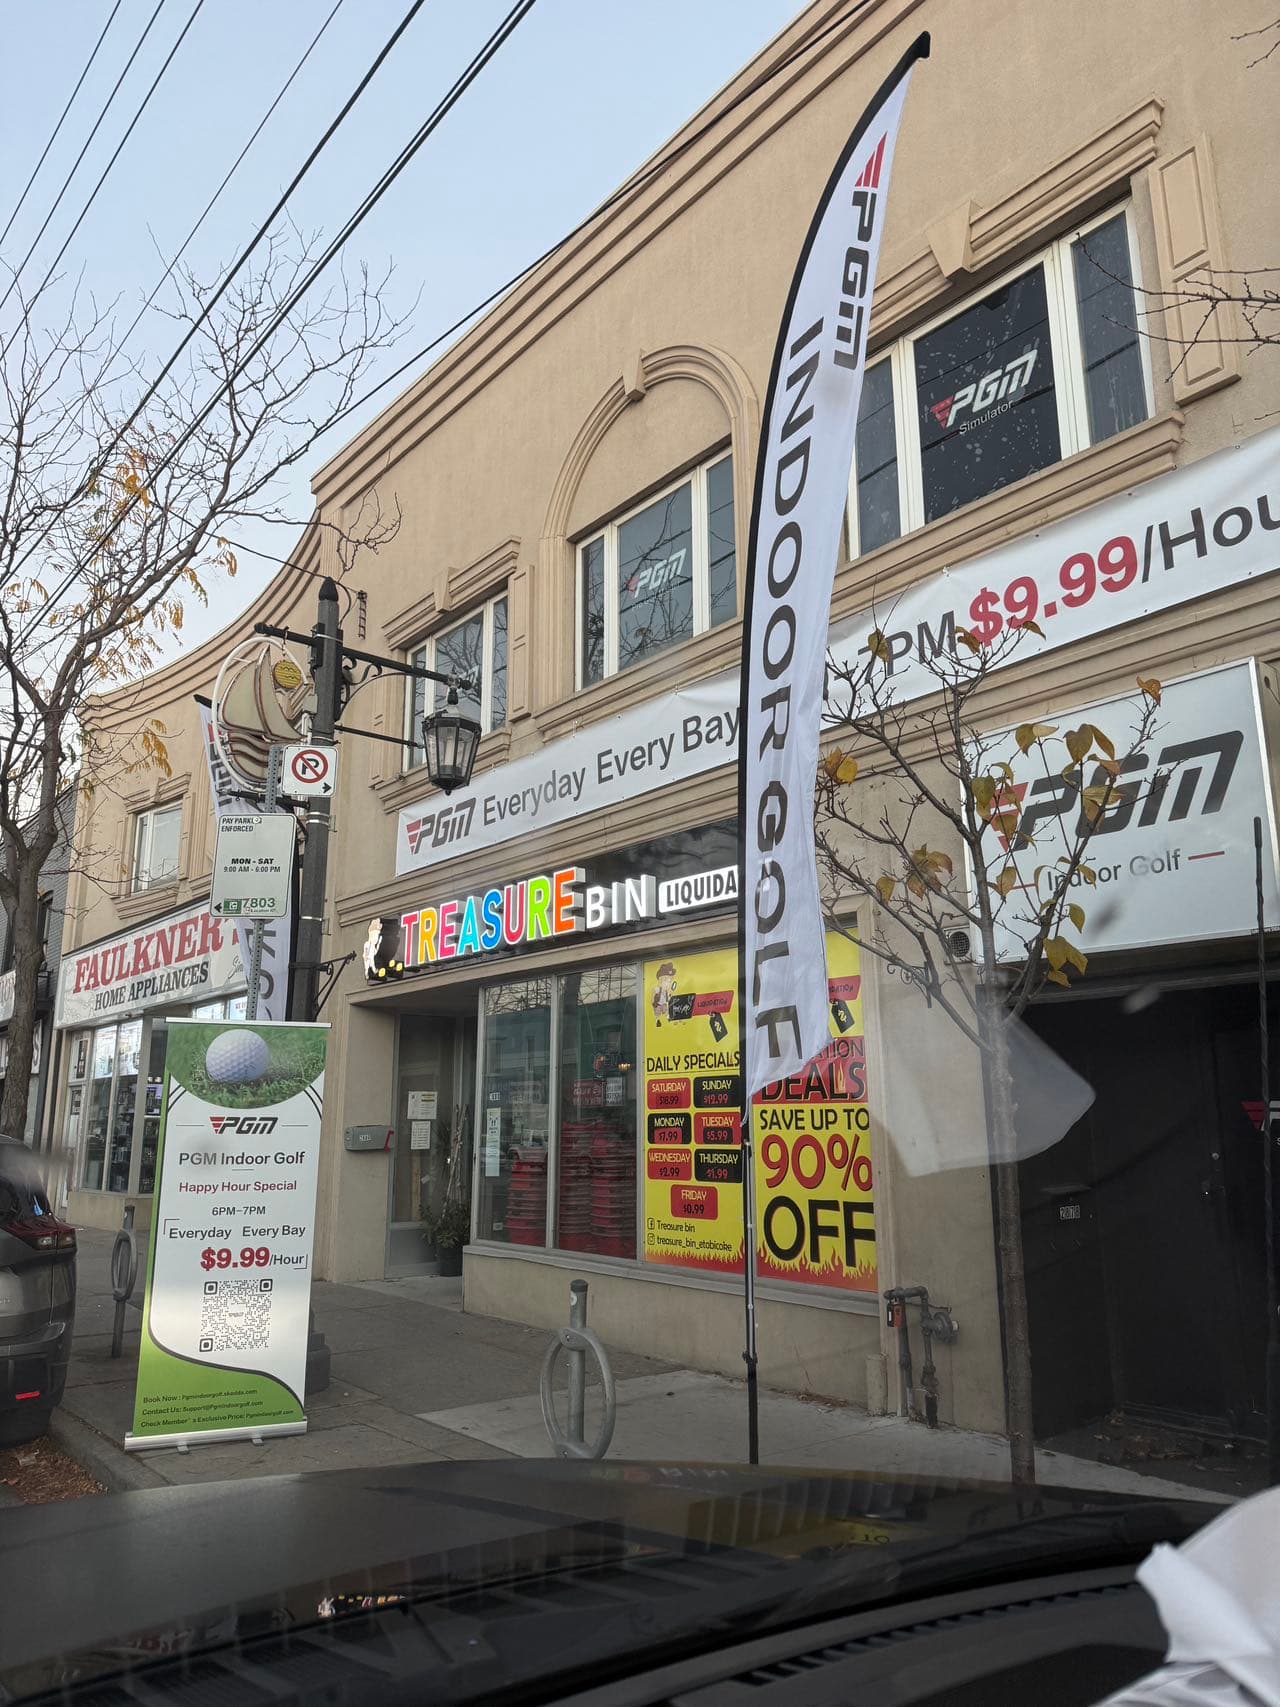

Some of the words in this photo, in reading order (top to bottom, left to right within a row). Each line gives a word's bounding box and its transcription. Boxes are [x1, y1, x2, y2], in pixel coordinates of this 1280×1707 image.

[834, 191, 877, 370] PGM
[946, 349, 1038, 428] PGM
[958, 400, 1013, 435] Simulator
[759, 317, 824, 760] INDOOR
[635, 548, 687, 598] PGM
[413, 798, 476, 854] PGM
[483, 768, 586, 826] Everyday
[597, 733, 675, 784] Every
[682, 706, 740, 752] Bay
[1129, 848, 1181, 876] Golf
[243, 898, 276, 908] 7803
[401, 866, 585, 967] TREASURE
[586, 874, 656, 929] BIN
[754, 780, 803, 1060] GOLF
[73, 911, 239, 994] FAULKNER'
[94, 985, 126, 1011] HOME
[128, 961, 209, 1002] APPLIANCES
[819, 1039, 864, 1058] TION
[647, 1055, 681, 1072] DAILY
[684, 1051, 740, 1070] SPECIALS
[652, 1082, 686, 1093] SATURDAY
[702, 1080, 732, 1091] SUNDAY
[762, 1061, 866, 1100] DEALS
[220, 1116, 279, 1135] PGM
[654, 1117, 684, 1127] MONDAY
[701, 1116, 734, 1127] TUESDAY
[760, 1109, 805, 1131] SAVE
[810, 1109, 840, 1130] UP
[845, 1108, 870, 1131] TO
[178, 1152, 217, 1165] PGM
[220, 1152, 271, 1165] Indoor
[273, 1151, 306, 1165] Golf
[648, 1152, 691, 1163] WEDNESDAY
[699, 1153, 738, 1165] THURSDAY
[761, 1133, 873, 1191] 90%
[178, 1181, 219, 1194] Happy
[221, 1181, 251, 1192] Hour
[253, 1180, 297, 1194] Special
[681, 1189, 707, 1201] FRIDAY
[169, 1226, 232, 1240] Everyday
[242, 1226, 280, 1239] Every
[281, 1225, 306, 1238] Bay
[657, 1220, 684, 1231] Treasure
[684, 1222, 696, 1232] bin
[763, 1196, 876, 1268] OFF
[143, 1396, 160, 1404] Book
[141, 1420, 161, 1428] Check
[197, 1414, 227, 1423] Exclusive
[142, 1408, 170, 1416] Contact
